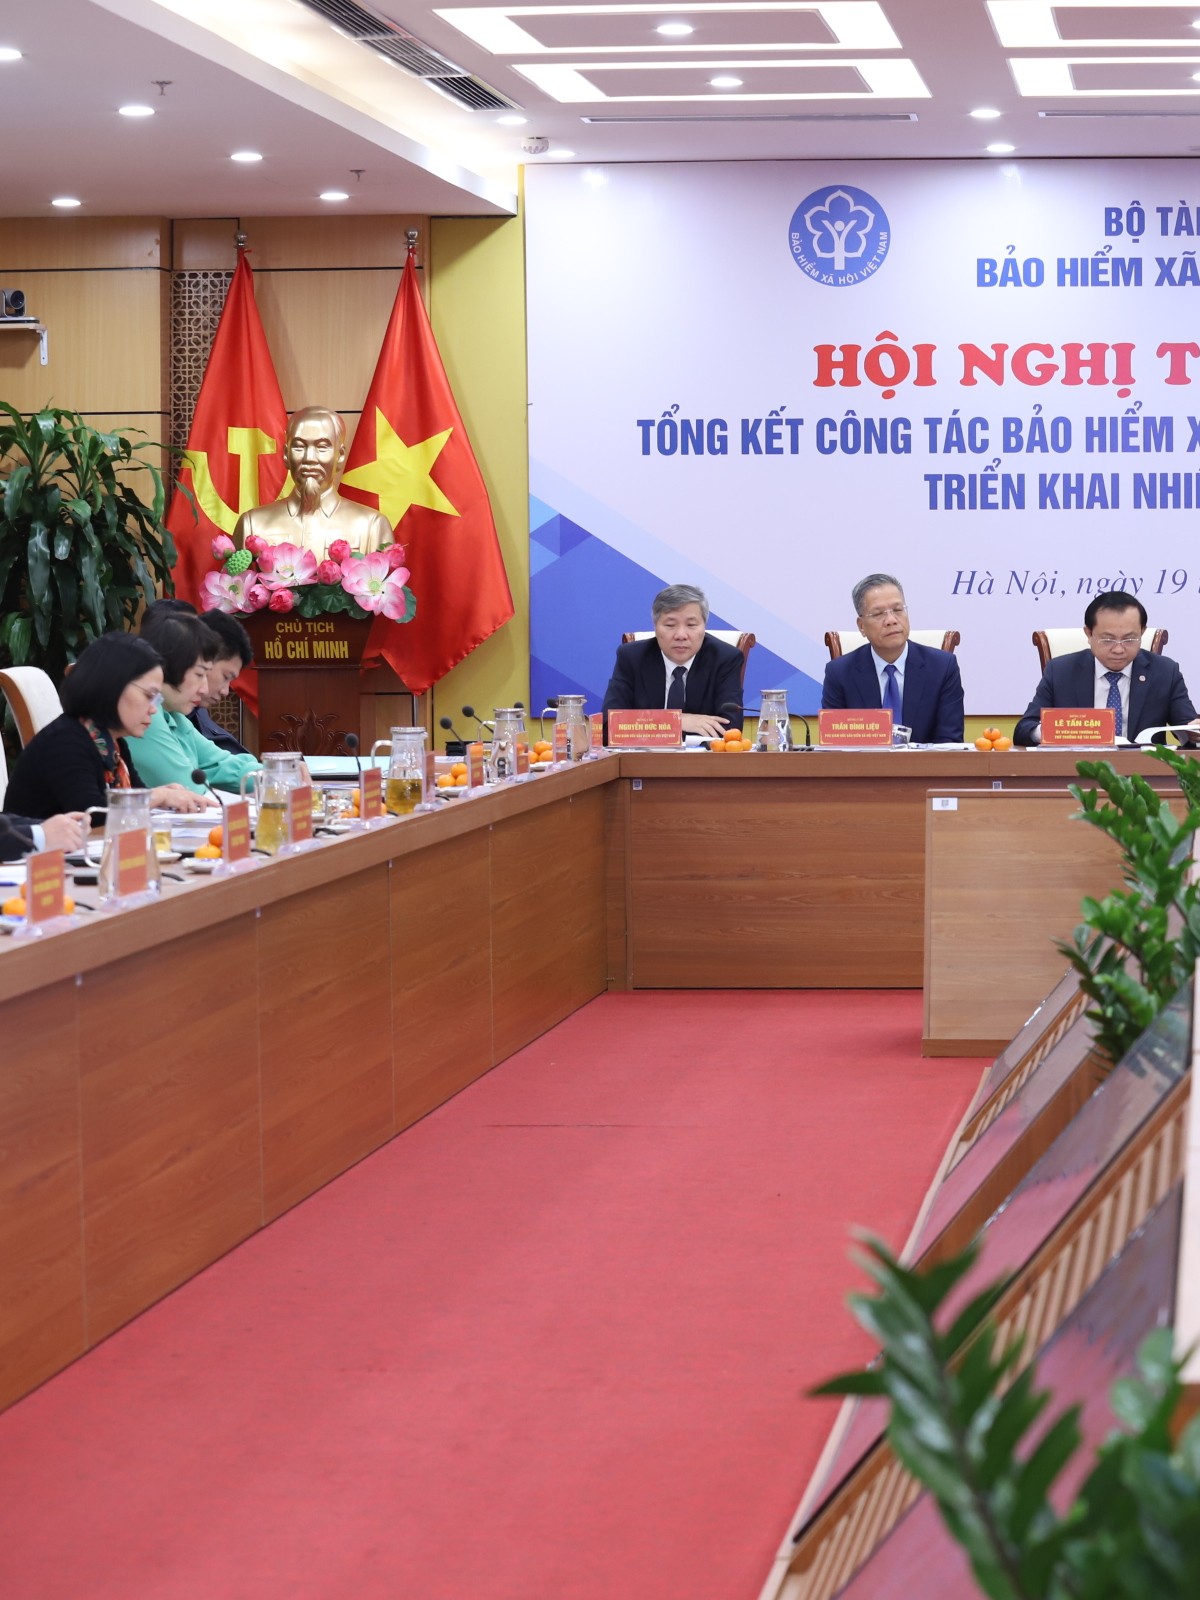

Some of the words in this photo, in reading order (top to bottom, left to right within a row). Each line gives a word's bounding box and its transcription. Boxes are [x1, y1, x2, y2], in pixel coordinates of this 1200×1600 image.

[1104, 200, 1145, 243] BỘ
[791, 232, 803, 254] BẢO
[797, 254, 820, 278] HIỂM
[820, 273, 834, 284] XÃ
[838, 273, 859, 285] HỘI
[859, 255, 881, 277] VIỆT
[876, 231, 888, 255] NAM
[976, 244, 1044, 287] BẢO
[1056, 244, 1142, 287] HIỂM
[813, 331, 937, 400] HỘI
[958, 342, 1136, 398] NGHỊ
[636, 403, 729, 456] TỔNG
[740, 405, 804, 455] KẾT
[815, 409, 912, 455] CÔNG
[923, 409, 990, 454] TÁC
[1002, 403, 1072, 454] BẢO
[1085, 401, 1174, 453] HIỂM
[923, 458, 1026, 510] TRIỂN
[1038, 472, 1120, 510] KHAI
[951, 569, 995, 595] Hà
[1005, 570, 1066, 602] Nội,
[1077, 570, 1143, 600] ngày
[1155, 569, 1188, 595] 19
[264, 634, 283, 659] HỒ
[286, 636, 309, 659] CHÍ
[312, 640, 349, 659] MINH
[275, 618, 302, 633] CHỦ
[305, 622, 334, 636] TỊCH
